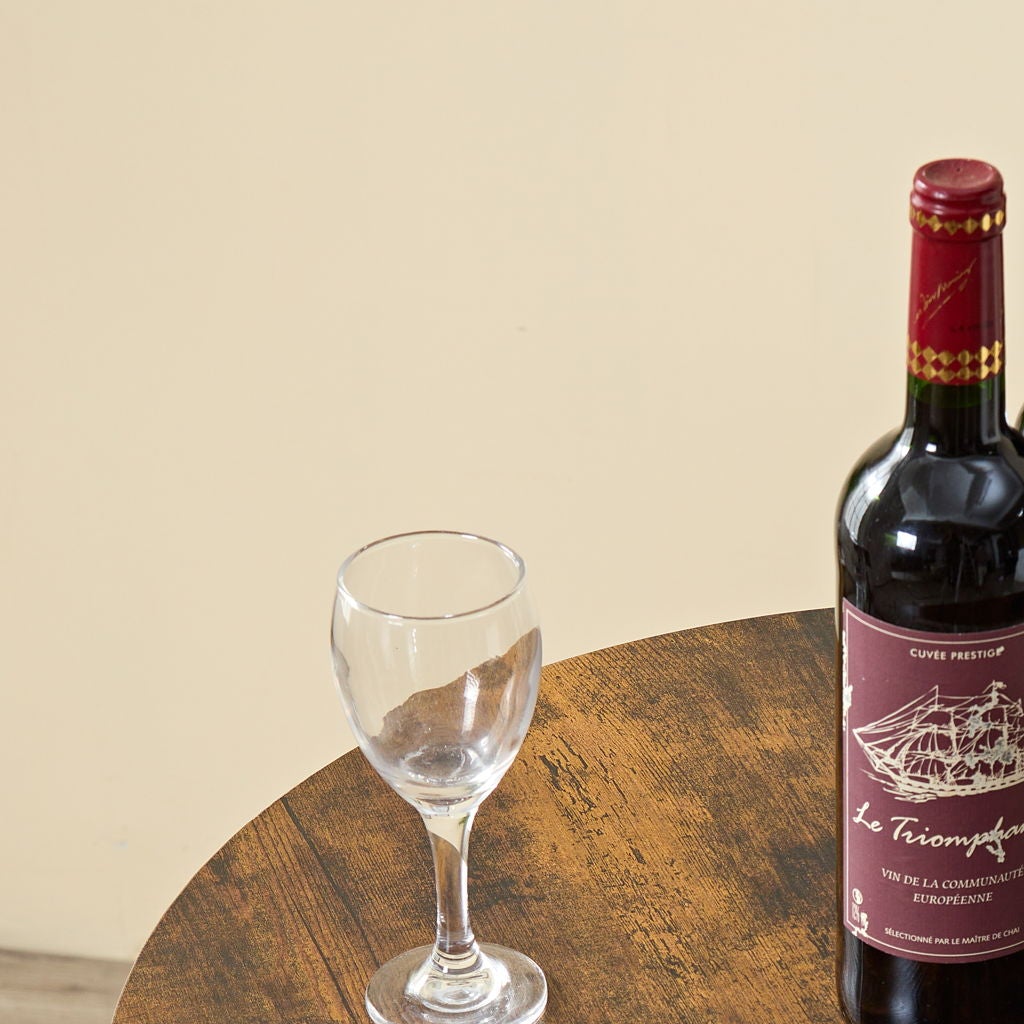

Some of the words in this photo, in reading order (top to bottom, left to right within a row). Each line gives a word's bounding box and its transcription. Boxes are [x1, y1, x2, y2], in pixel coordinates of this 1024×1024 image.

[910, 647, 947, 660] CUVÉE
[853, 801, 884, 832] Le
[881, 867, 900, 882] VIN
[904, 875, 920, 887] DE
[923, 877, 939, 889] LA
[942, 864, 1024, 890] COMMUNAUTÉ
[913, 891, 994, 906] EUROPÉENNE
[885, 927, 933, 944] SÉLECTIONNÉ
[935, 937, 950, 945] PAR
[951, 937, 960, 945] LE
[962, 933, 991, 945] MAÎTRE
[992, 931, 1002, 940] DE
